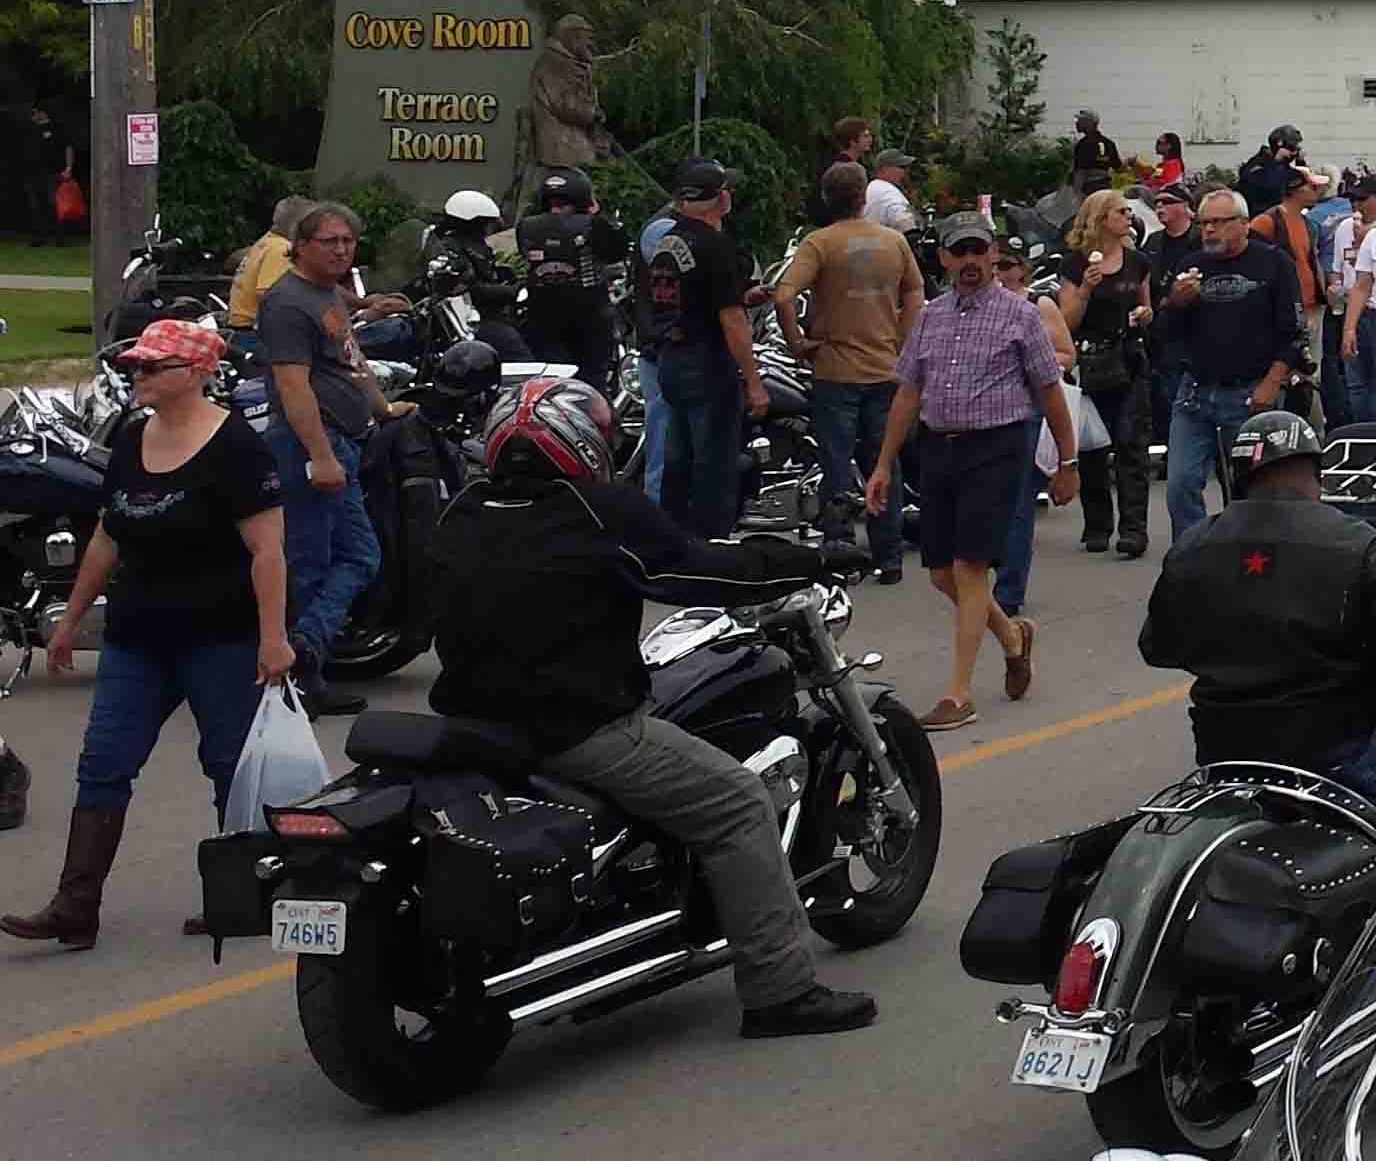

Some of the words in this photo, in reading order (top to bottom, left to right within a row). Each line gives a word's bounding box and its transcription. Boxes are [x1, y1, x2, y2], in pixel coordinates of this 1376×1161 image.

[345, 12, 425, 49] Cove
[431, 13, 531, 49] Room
[377, 87, 498, 122] Terrace
[387, 126, 485, 161] Room
